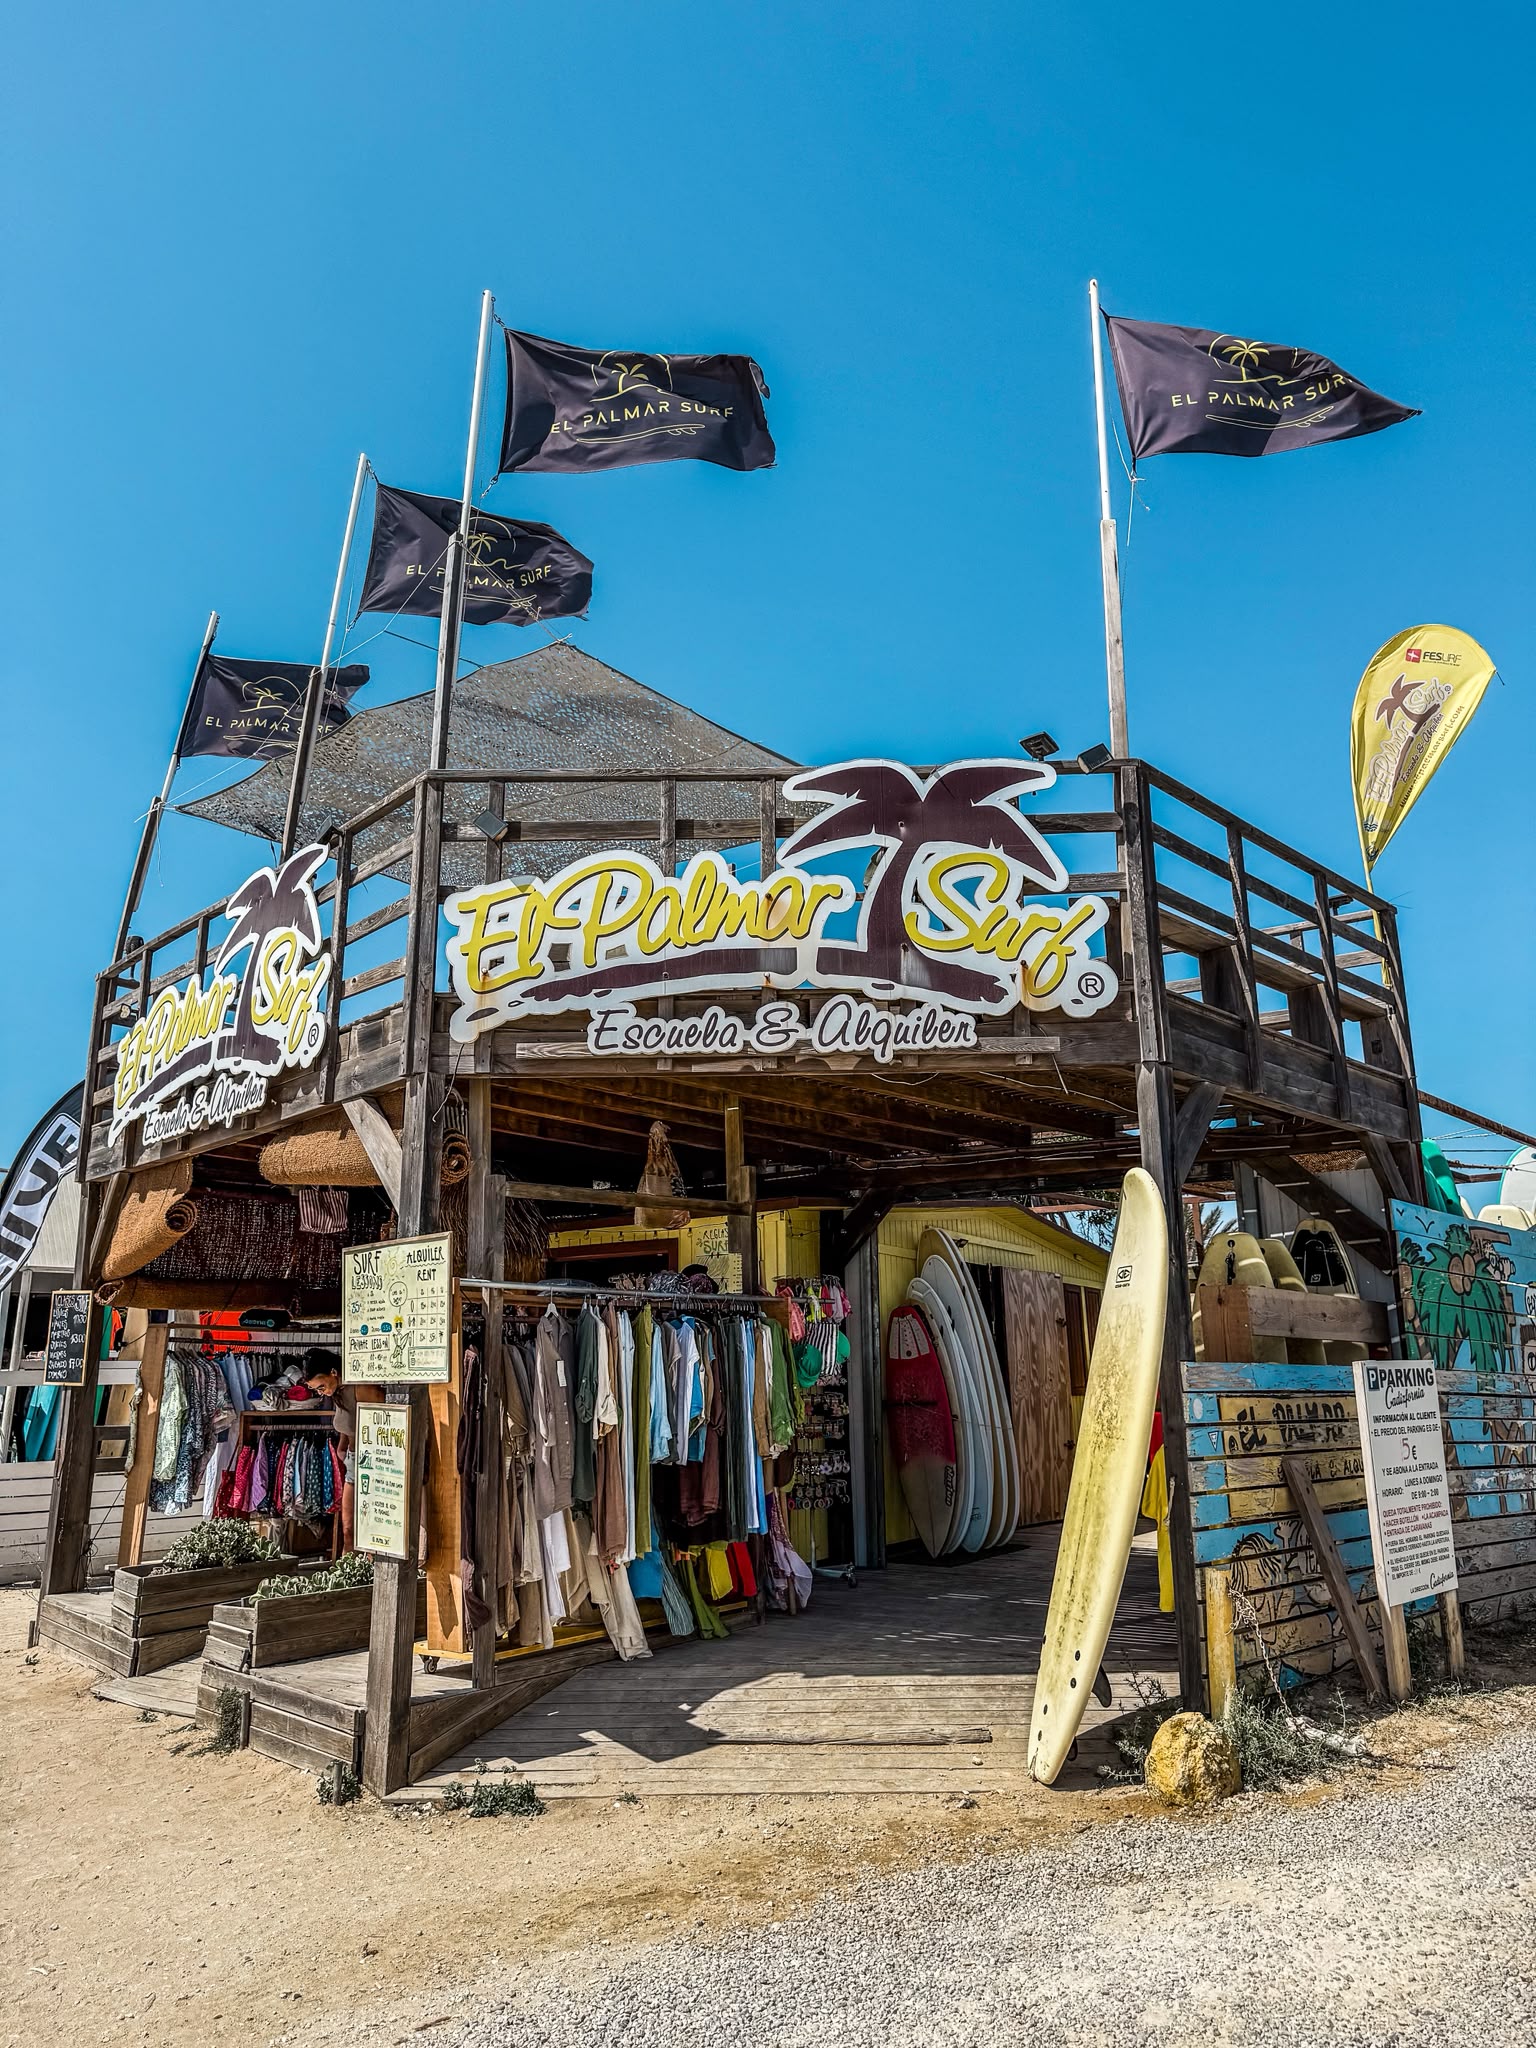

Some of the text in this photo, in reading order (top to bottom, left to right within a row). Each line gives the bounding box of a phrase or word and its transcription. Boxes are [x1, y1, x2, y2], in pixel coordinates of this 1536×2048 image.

[1171, 393, 1198, 408] EL
[1208, 391, 1295, 411] PALMAR
[550, 421, 573, 434] EL
[583, 401, 670, 428] PALMAR
[406, 564, 425, 576] EL
[520, 564, 552, 587] SURF
[205, 716, 223, 728] EL
[230, 717, 290, 733] PALMAR
[456, 884, 546, 994] El
[544, 858, 844, 968] Palmar
[904, 851, 1096, 998] Surf
[140, 980, 233, 1080] Palmar
[252, 931, 325, 1053] Surf
[594, 1001, 974, 1063] Escuela & Alquiler
[144, 1076, 264, 1140] Escuela & Alquiler
[353, 1250, 382, 1276] SURF
[417, 1268, 437, 1281] RENT
[1379, 1367, 1435, 1388] PARKING
[1373, 1411, 1437, 1424] INFORMACIÓN AL CLIENTE
[361, 1425, 406, 1451] EL PALMAR
[1374, 1428, 1380, 1437] EL
[1381, 1427, 1397, 1437] PRECIO
[1398, 1426, 1407, 1435] DEL
[1407, 1425, 1426, 1434] PARKING
[1426, 1424, 1433, 1433] ES
[1386, 1467, 1393, 1476] SE
[1393, 1466, 1409, 1475] ABONA
[1419, 1462, 1439, 1472] ENTRADA
[1404, 1477, 1419, 1487] LUNES
[1423, 1474, 1443, 1485] DOMINGO
[1383, 1508, 1397, 1518] QUEDA
[1397, 1504, 1421, 1515] TOTALMENTE
